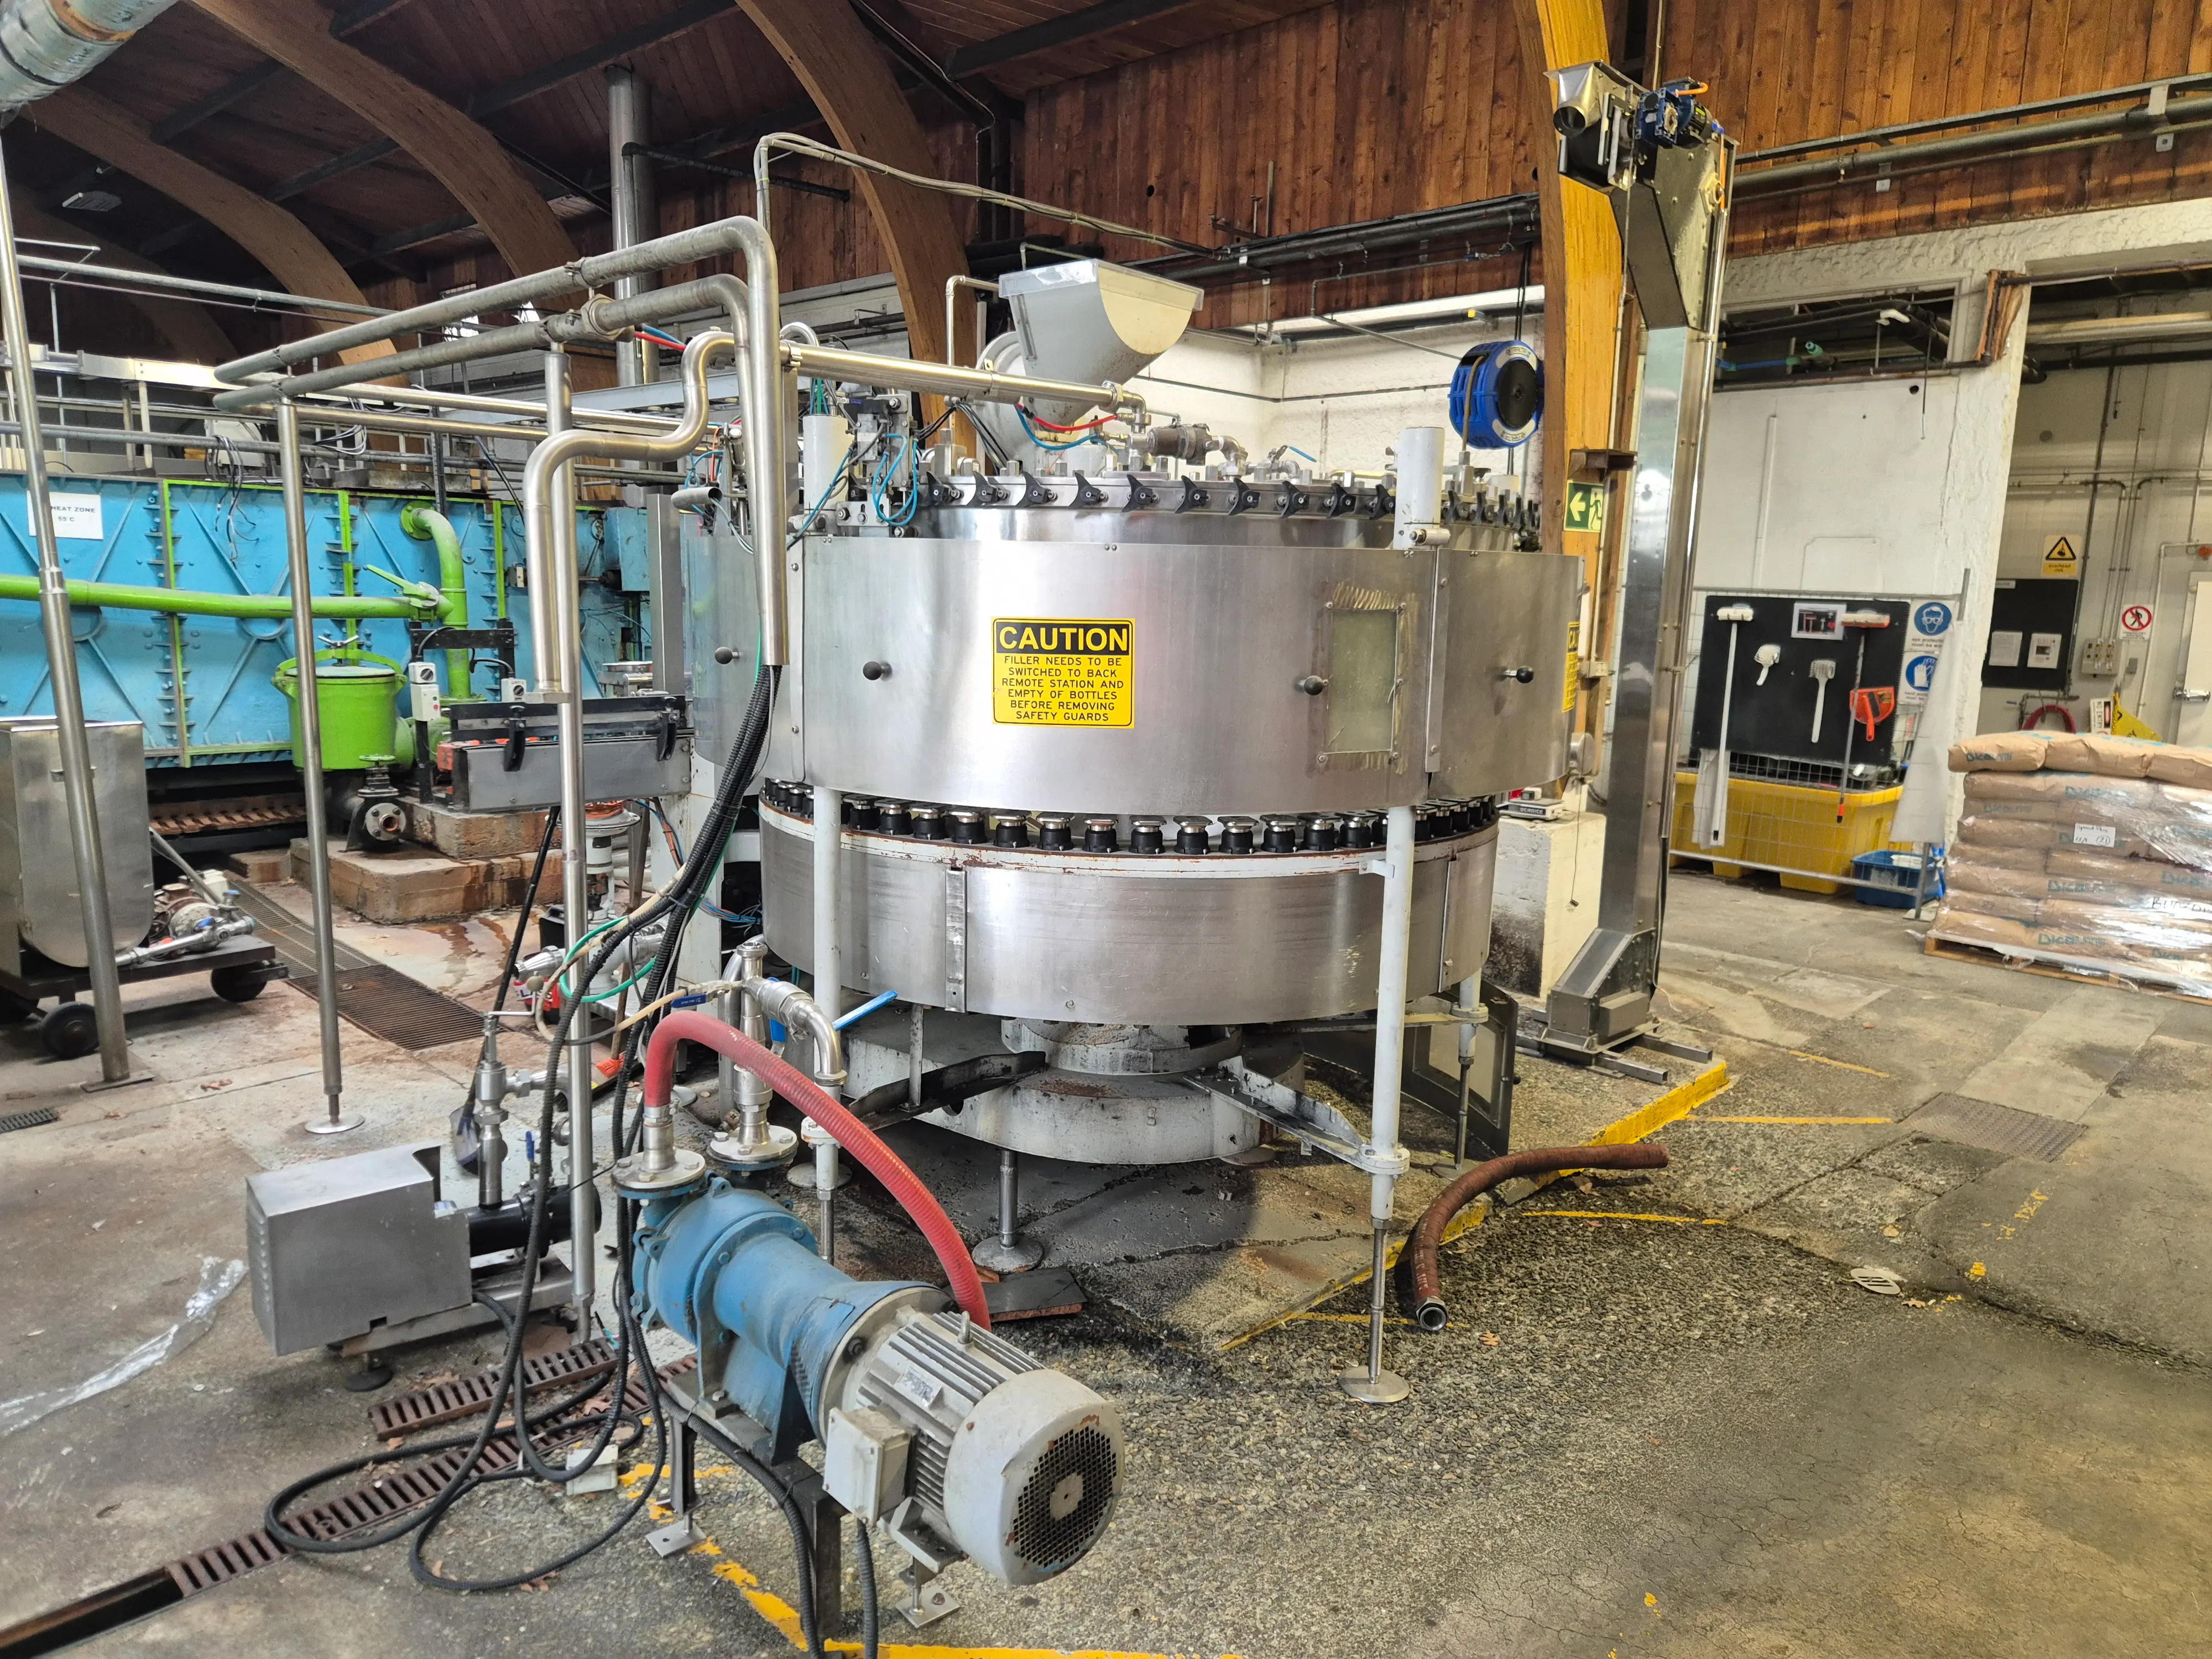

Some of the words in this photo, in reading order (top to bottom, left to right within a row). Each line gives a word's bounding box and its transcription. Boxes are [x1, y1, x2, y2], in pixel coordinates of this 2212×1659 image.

[999, 627, 1127, 651] CAUTION
[1005, 656, 1040, 664] FILLER
[1046, 657, 1081, 665] NEEDS
[1108, 658, 1121, 666] BE
[1009, 668, 1061, 676] SWITCHED
[1087, 669, 1117, 677] BACK
[1002, 678, 1044, 687] REMOTE
[1050, 680, 1094, 688] STATION
[1008, 690, 1044, 698] EMPTY
[1050, 690, 1063, 698] OF
[1070, 691, 1117, 700] BOTTLES
[1011, 700, 1052, 709] BEFORE
[1058, 701, 1115, 710] REMOVING
[1016, 711, 1057, 720] SAFETY
[1064, 712, 1109, 721] GUARDS
